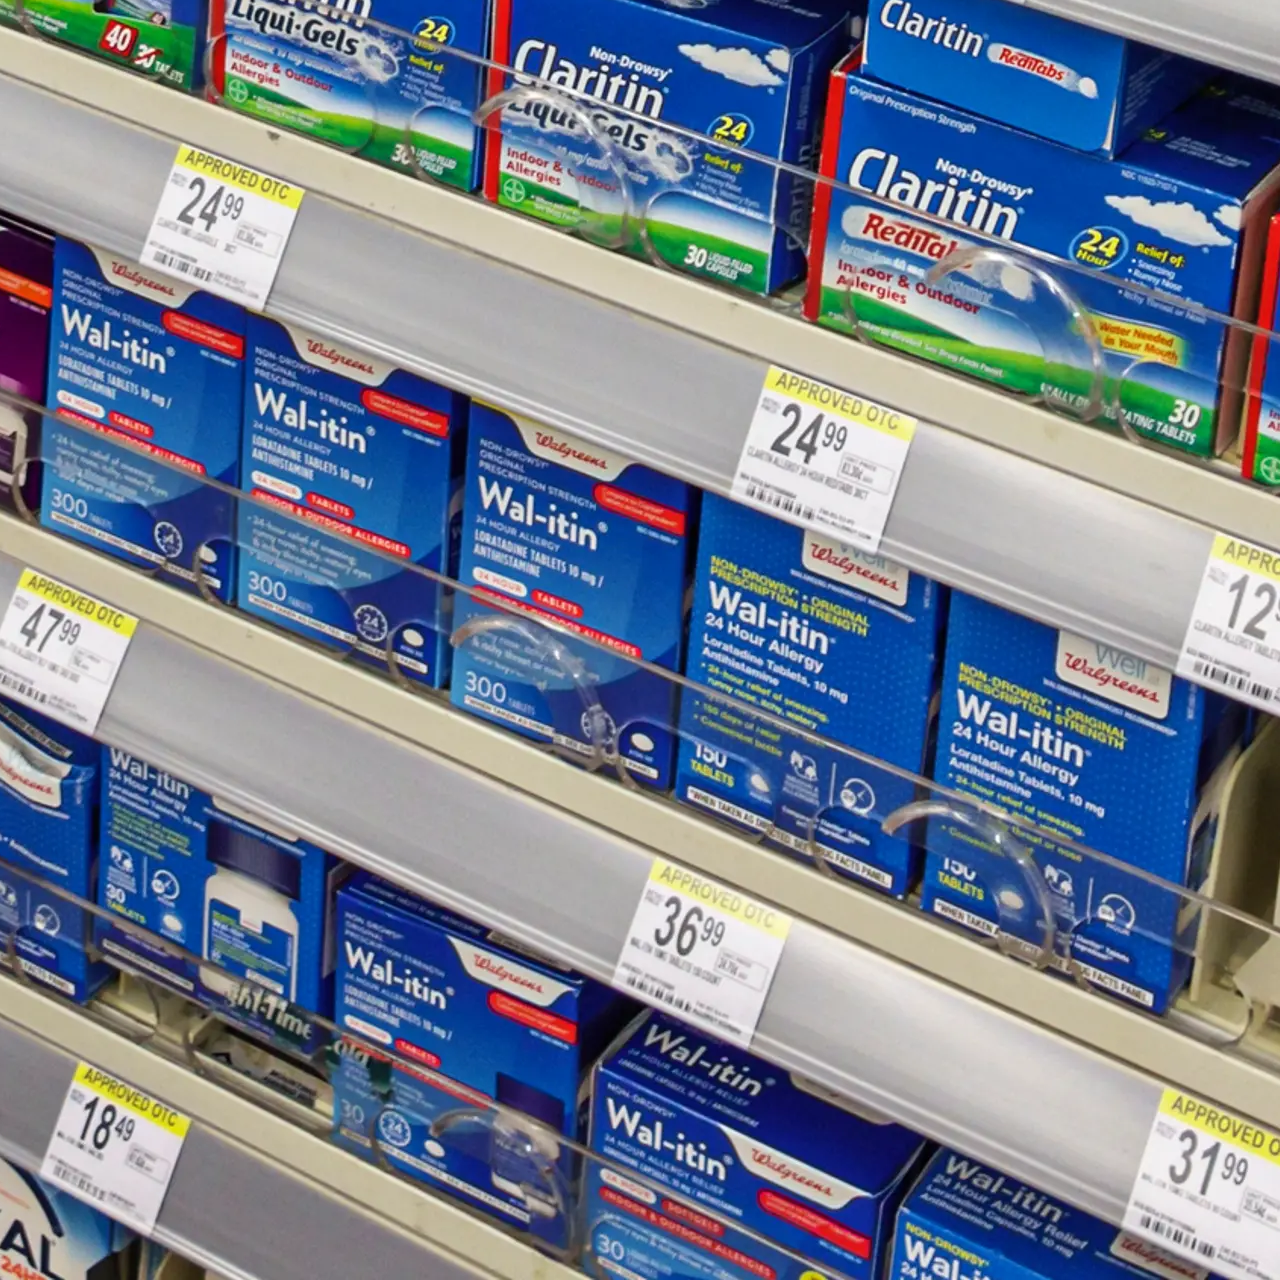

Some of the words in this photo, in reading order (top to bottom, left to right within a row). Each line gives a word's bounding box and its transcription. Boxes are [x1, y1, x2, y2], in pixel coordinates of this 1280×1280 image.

[999, 47, 1065, 81] RediTabs
[254, 383, 366, 454] Wal-itin
[810, 541, 899, 591] Walgreens
[709, 580, 830, 655] Wal-itin
[464, 672, 506, 702] 300
[952, 721, 971, 740] 24
[976, 732, 1016, 758] Hour
[1020, 752, 1079, 786] Allergy
[957, 690, 1086, 767] Wal-itin
[344, 942, 448, 1010] Wal-itin
[604, 1098, 733, 1180] Wal-itin
[1171, 1095, 1262, 1148] APPROVED
